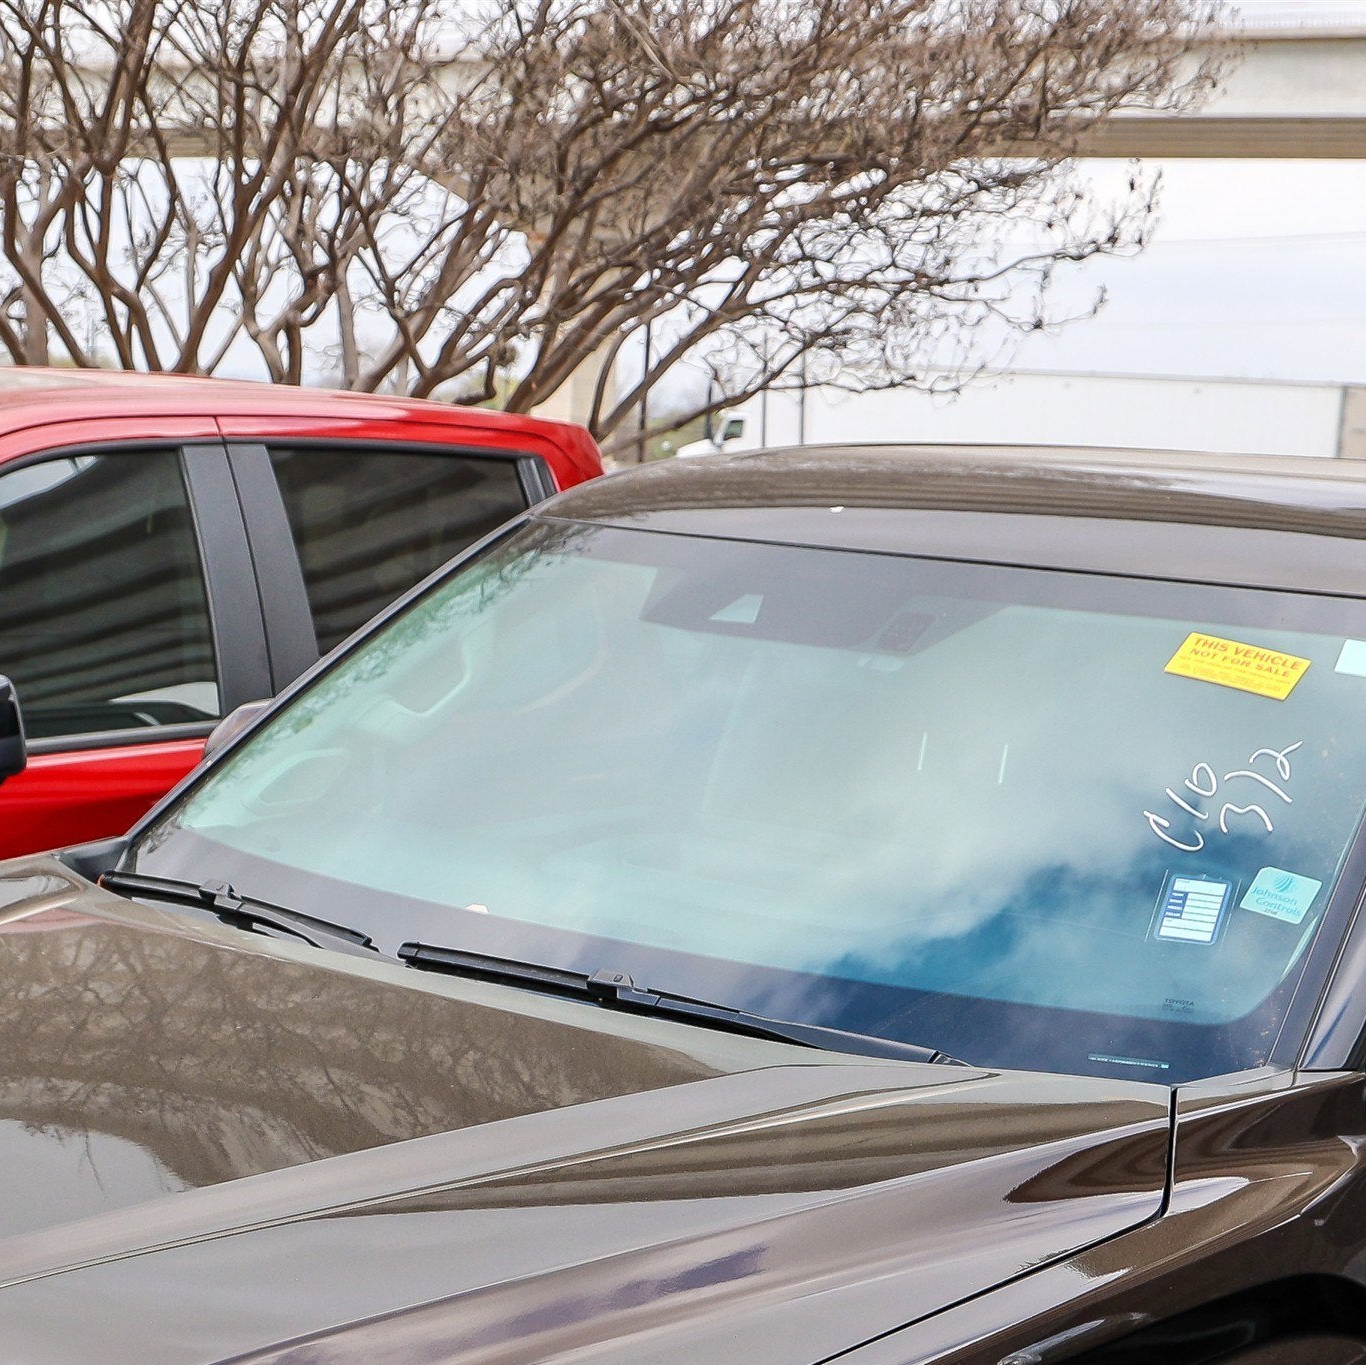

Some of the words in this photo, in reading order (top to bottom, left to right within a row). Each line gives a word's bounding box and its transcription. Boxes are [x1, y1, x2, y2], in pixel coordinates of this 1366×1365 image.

[1190, 647, 1218, 659] NOT
[1222, 655, 1252, 668] FOR
[1255, 663, 1292, 678] SALE
[1193, 638, 1229, 652] THIS
[1235, 646, 1304, 671] VEHICLE
[1250, 886, 1299, 906] Johnson
[1255, 896, 1302, 918] Controls
